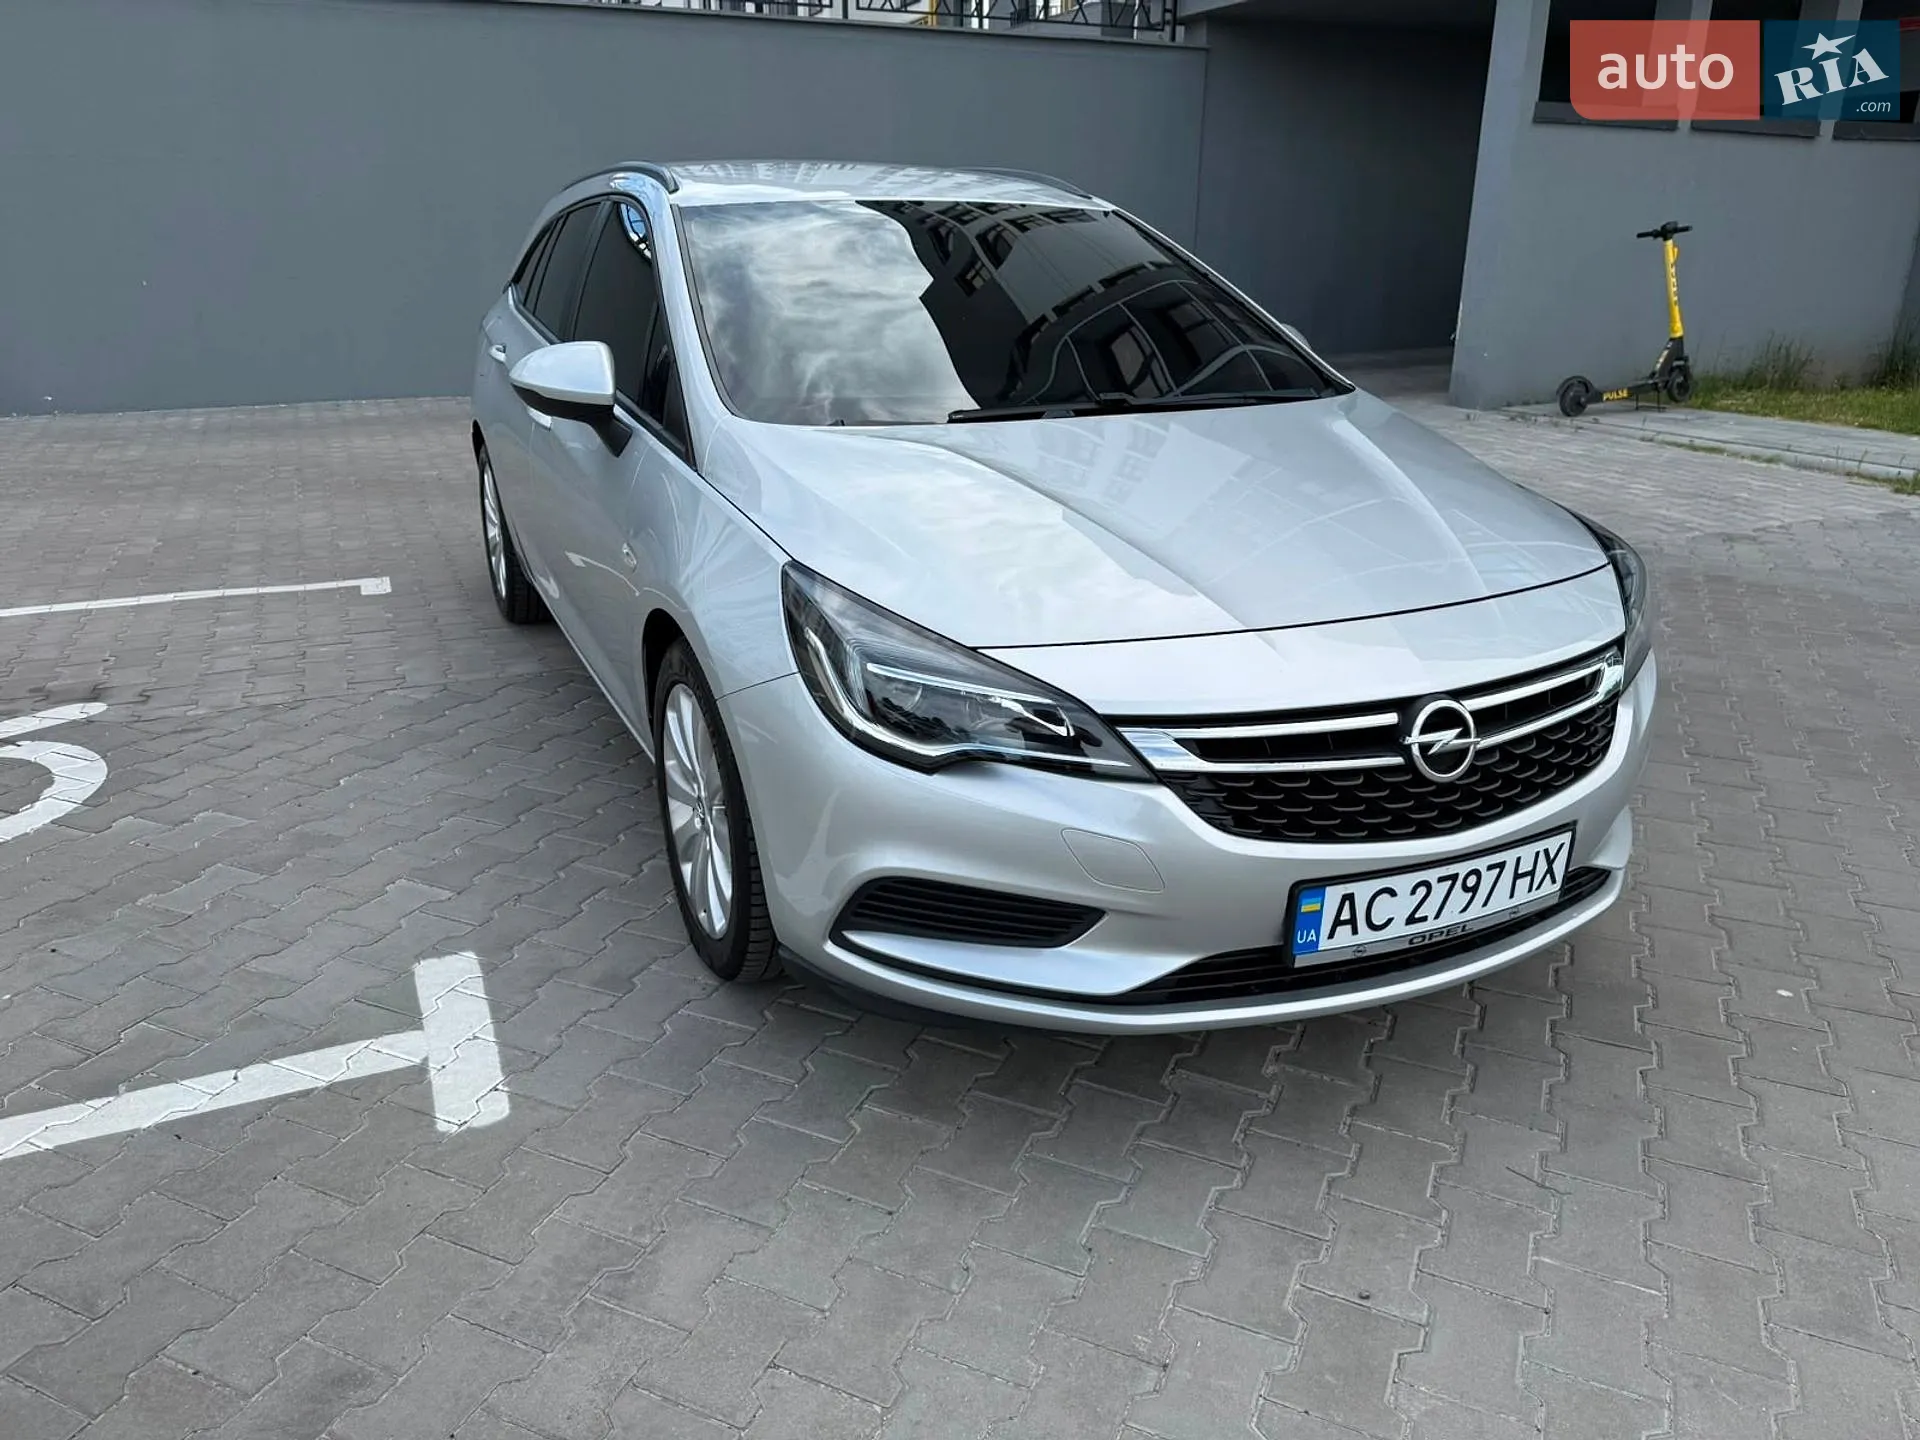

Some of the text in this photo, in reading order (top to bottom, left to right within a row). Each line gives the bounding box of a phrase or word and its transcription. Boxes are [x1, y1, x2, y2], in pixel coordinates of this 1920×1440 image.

[1602, 388, 1629, 401] PULSE
[1327, 842, 1565, 940] AC 2797 HX
[1297, 928, 1317, 944] UA
[1408, 923, 1475, 946] OPEL
